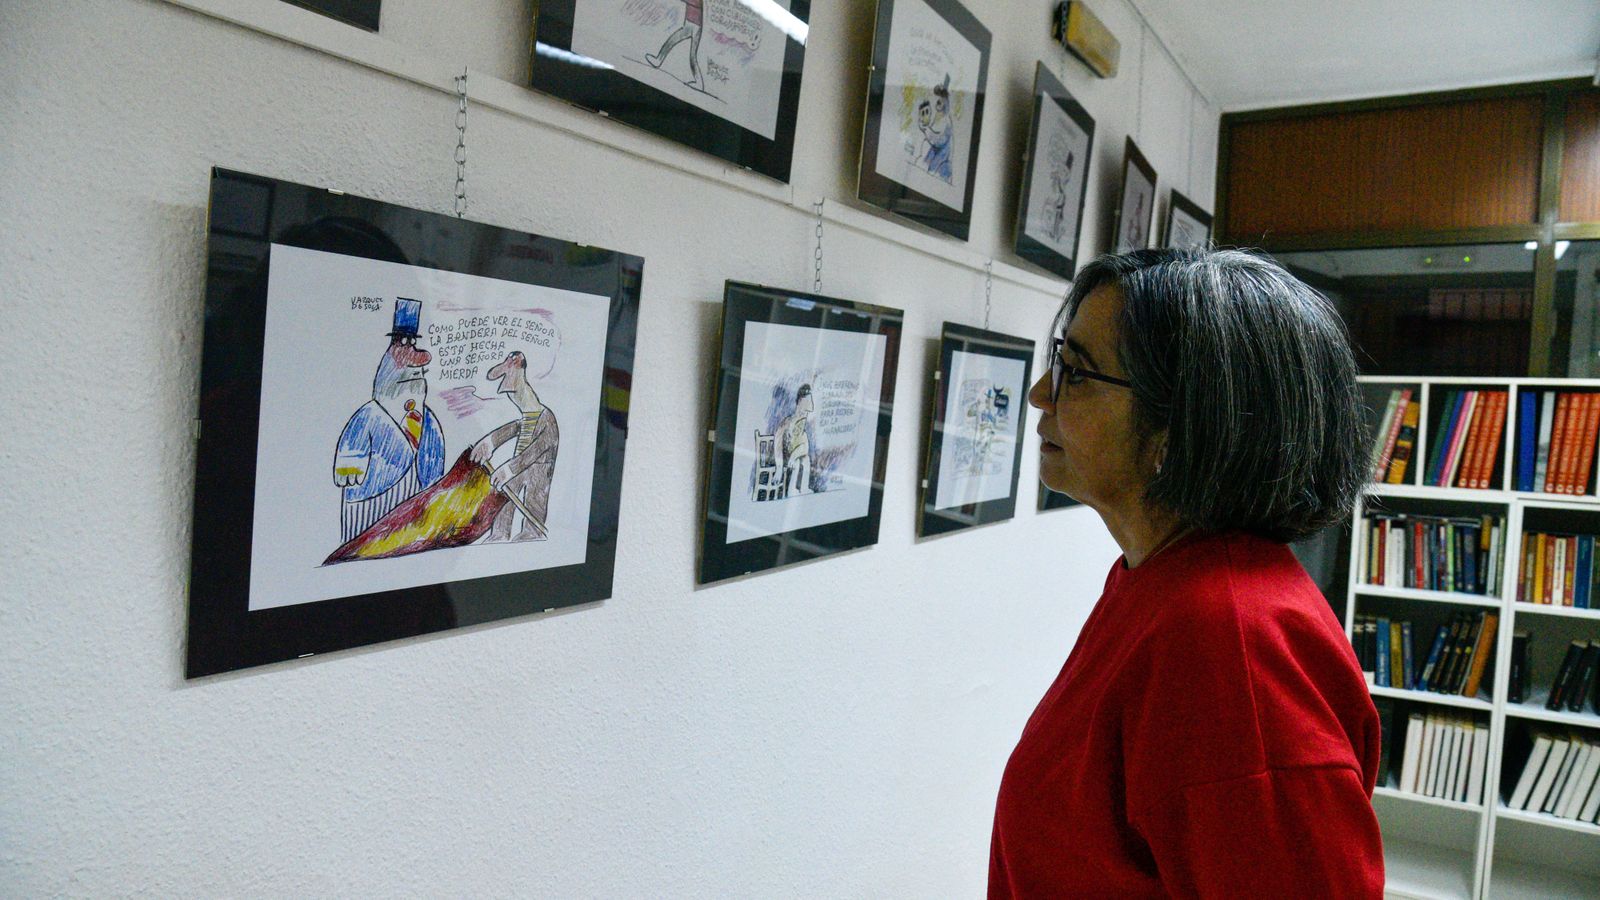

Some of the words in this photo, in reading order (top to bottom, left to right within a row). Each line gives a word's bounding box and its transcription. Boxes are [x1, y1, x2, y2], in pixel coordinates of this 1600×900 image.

[428, 323, 453, 334] COMO
[458, 316, 490, 330] PUEDE
[493, 315, 509, 326] VER
[511, 317, 523, 328] EL
[525, 320, 555, 337] SEÑOR
[430, 335, 442, 347] LA
[446, 327, 497, 344] BANDERA
[501, 327, 518, 338] DEL
[521, 331, 550, 347] SEÑOR
[470, 340, 505, 352] HECHA
[440, 356, 462, 367] UNA
[465, 350, 504, 365] SEÑORA
[439, 366, 479, 380] MIERDA
